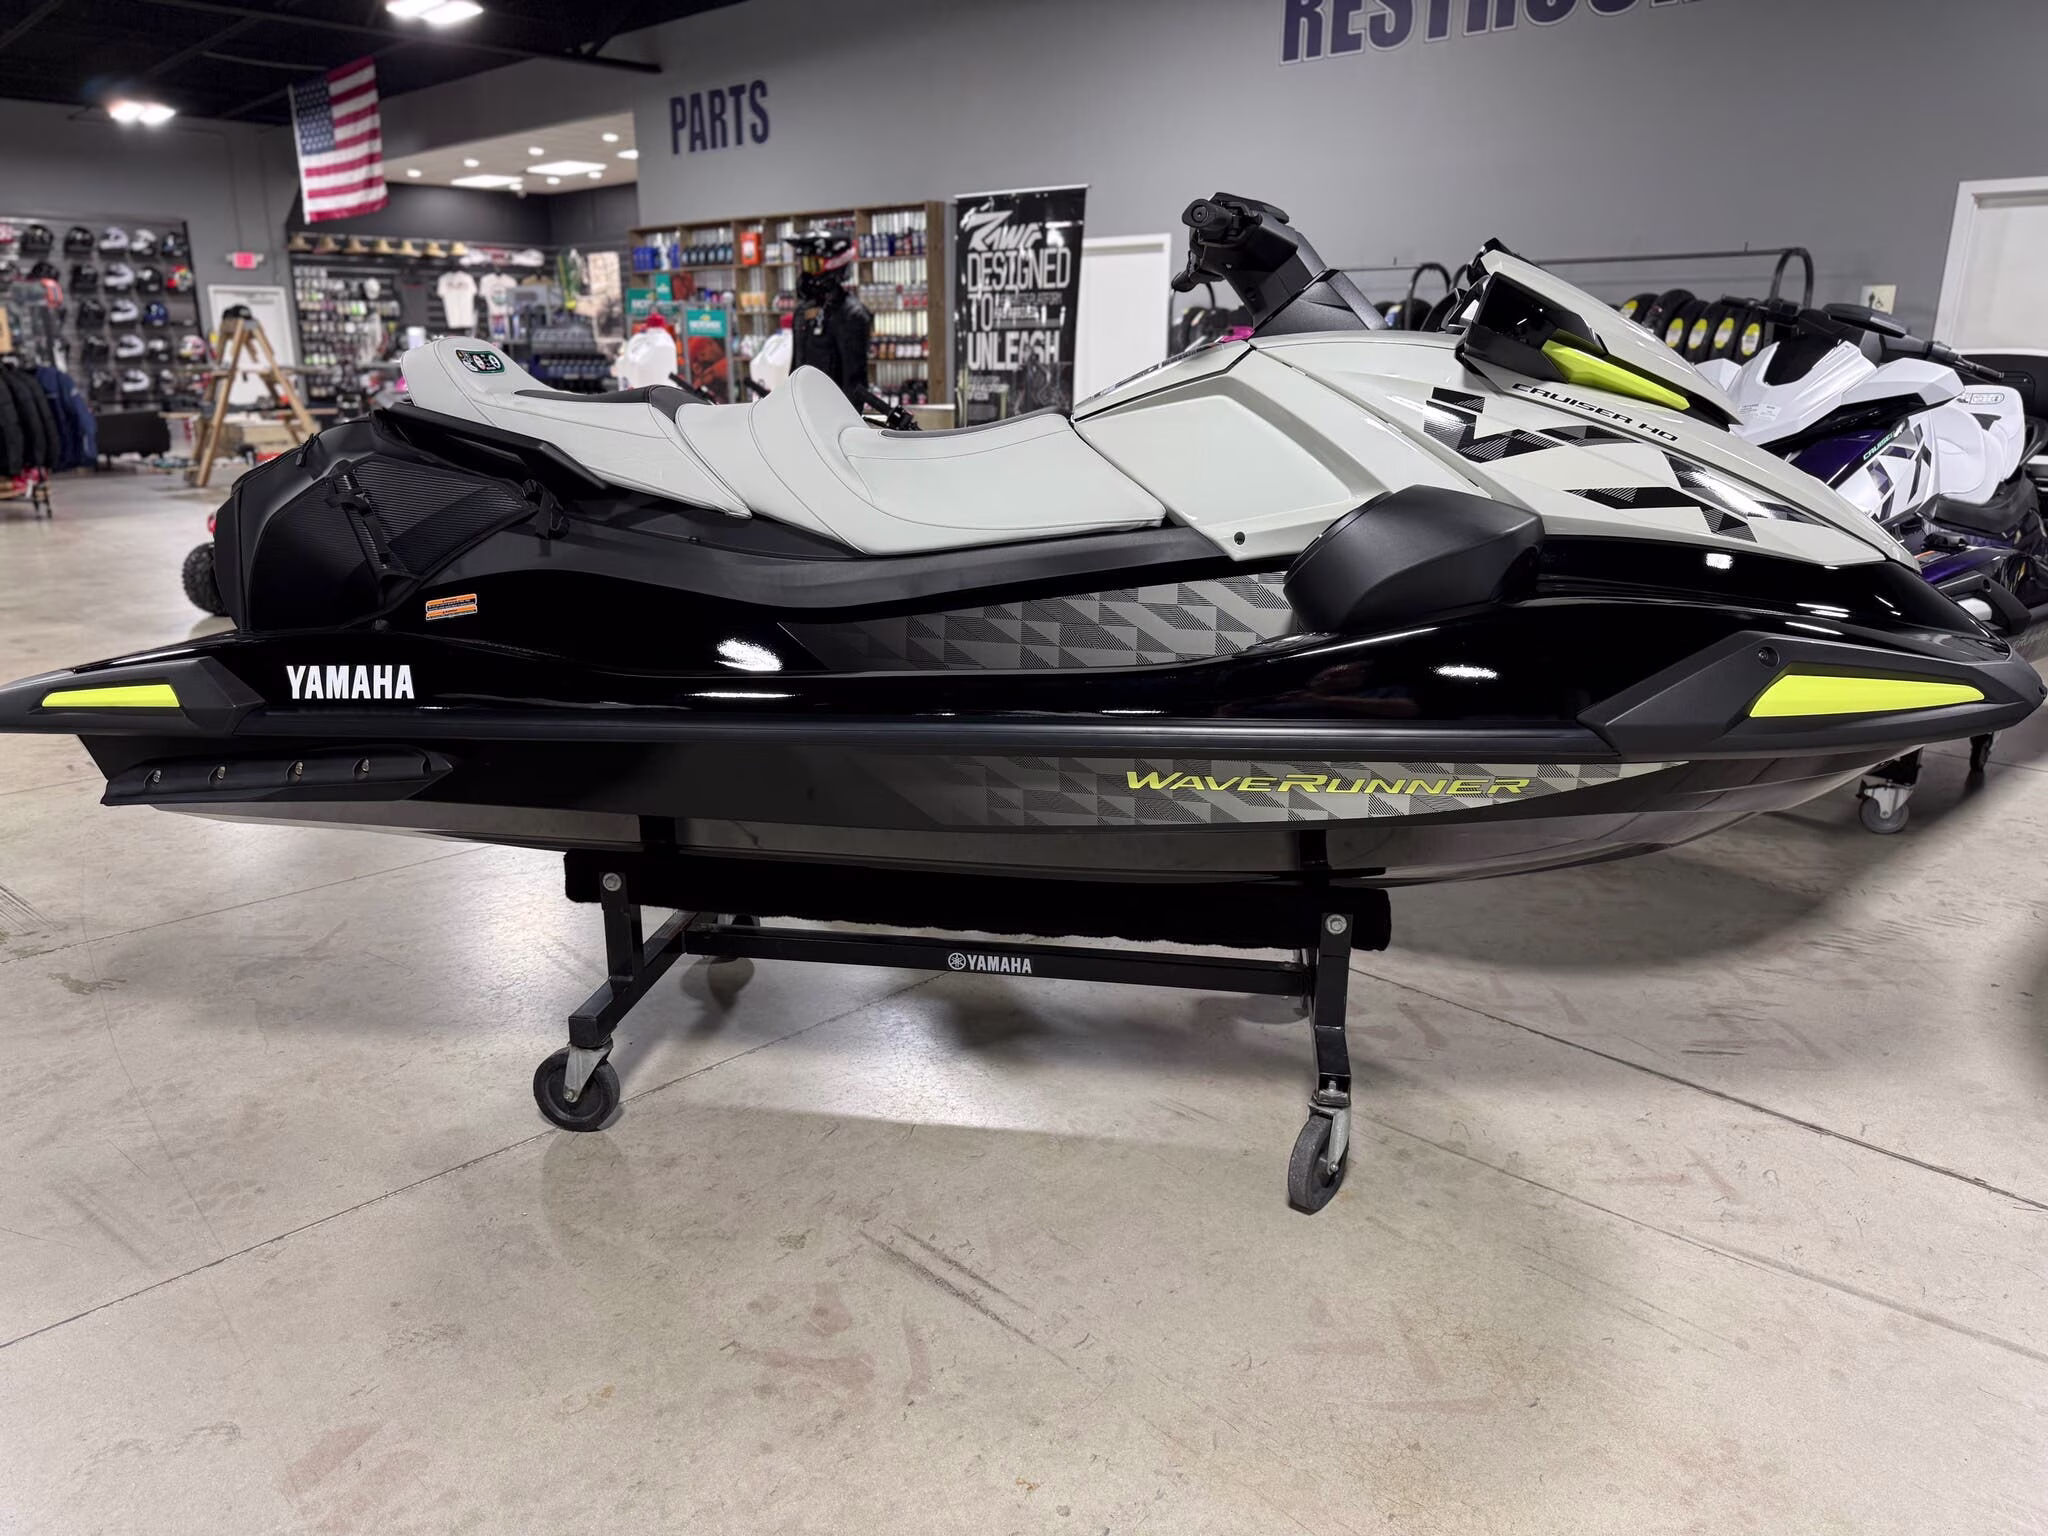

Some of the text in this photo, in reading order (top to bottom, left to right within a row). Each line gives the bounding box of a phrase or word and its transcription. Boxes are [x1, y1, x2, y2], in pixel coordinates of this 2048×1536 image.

[669, 79, 769, 155] PARTS
[967, 247, 1072, 292] DESIGNED
[967, 293, 993, 331] TO
[967, 330, 1061, 371] UNLEASH
[1512, 383, 1679, 442] CRUISER HO
[286, 665, 415, 700] YAMAHA
[967, 954, 1032, 974] YAMAHA
